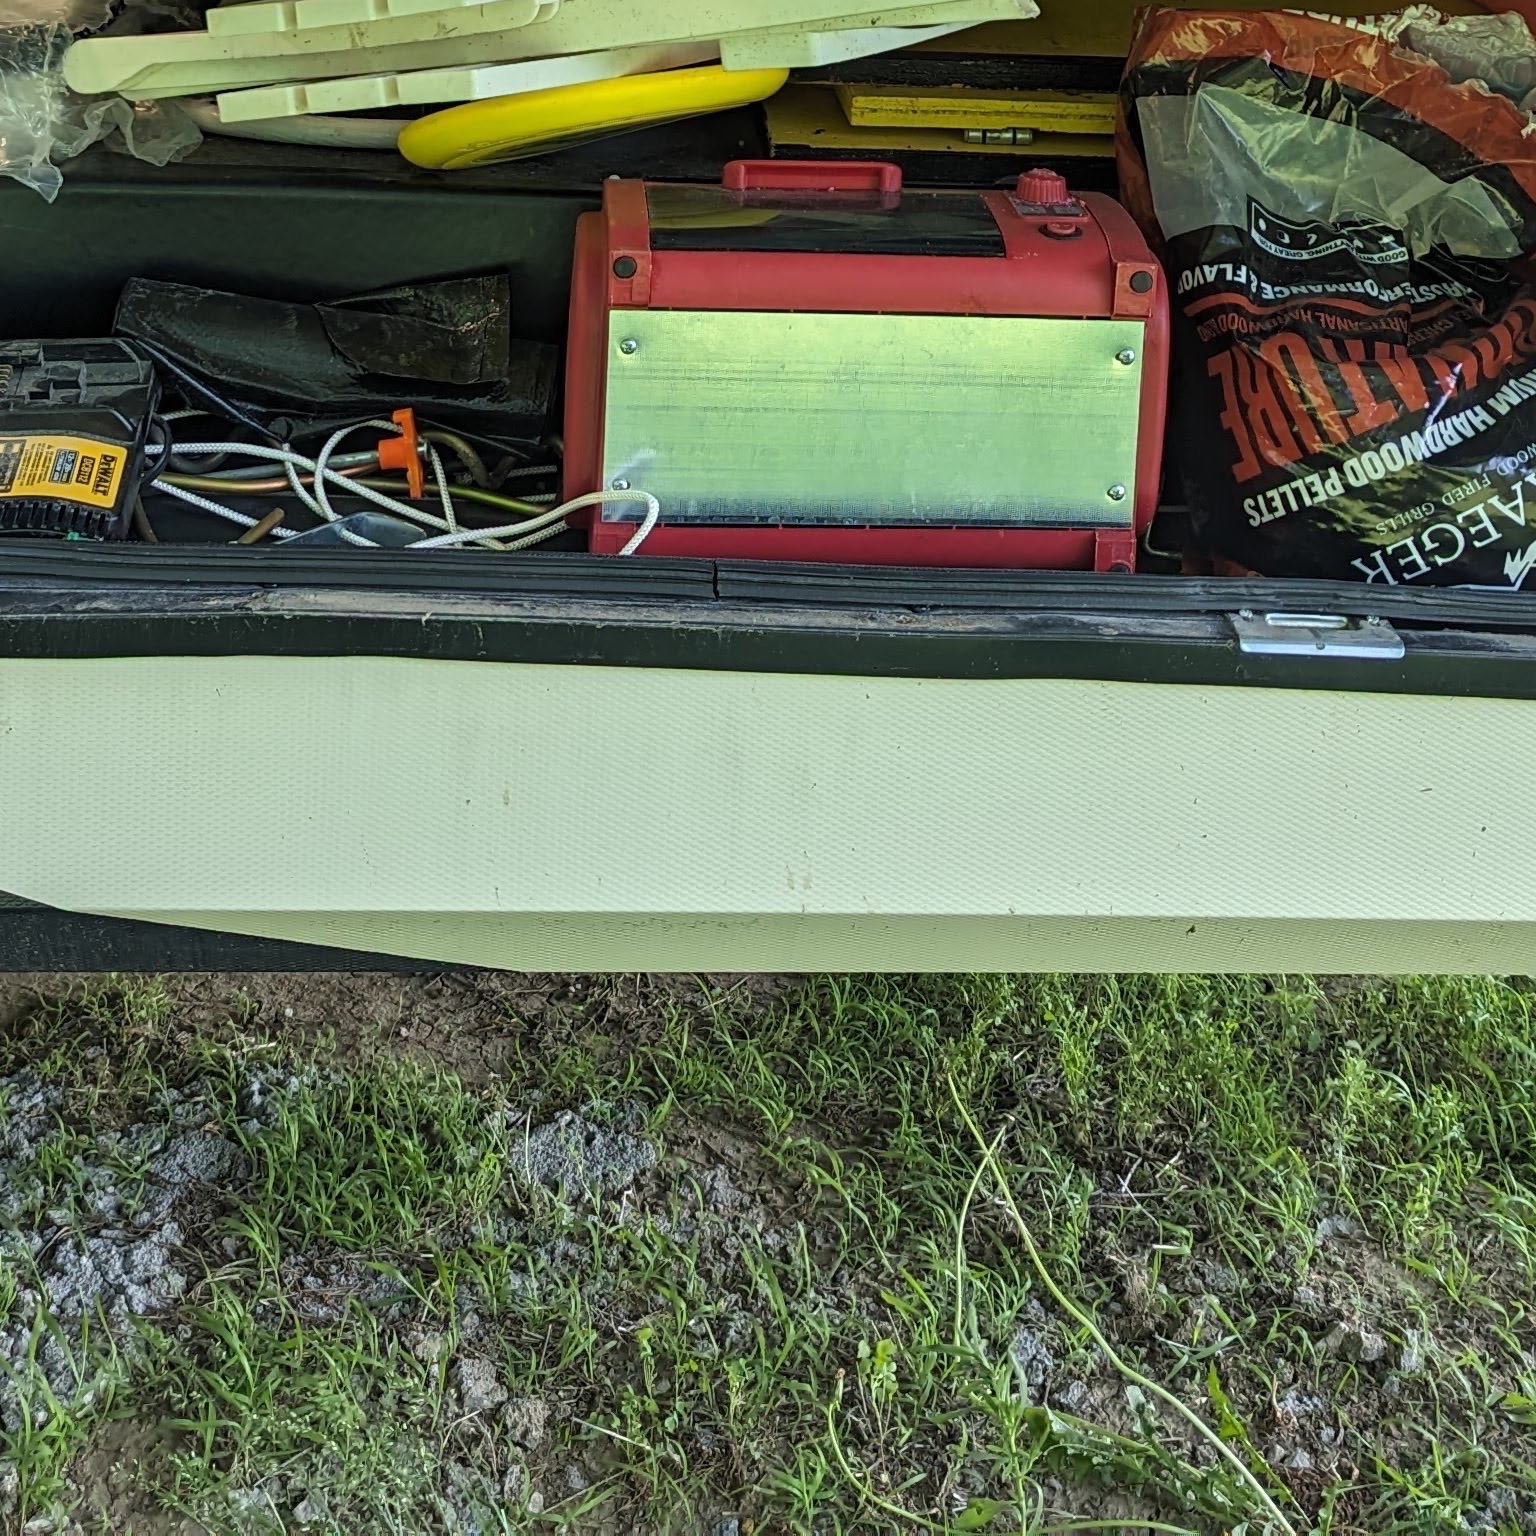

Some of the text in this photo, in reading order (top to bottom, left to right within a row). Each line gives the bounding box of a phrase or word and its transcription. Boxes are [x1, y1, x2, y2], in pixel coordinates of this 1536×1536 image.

[1273, 247, 1304, 257] GREAT
[1377, 250, 1407, 263] GOOD
[1260, 277, 1411, 303] ERFORMANCE
[1409, 281, 1473, 304] TRUST
[1317, 311, 1409, 334] ARTISANAL
[1344, 405, 1491, 485] HARDWOOD
[1241, 459, 1345, 528] PELLETS
[1440, 472, 1492, 506] FIRED
[1375, 501, 1435, 536] GRILLS
